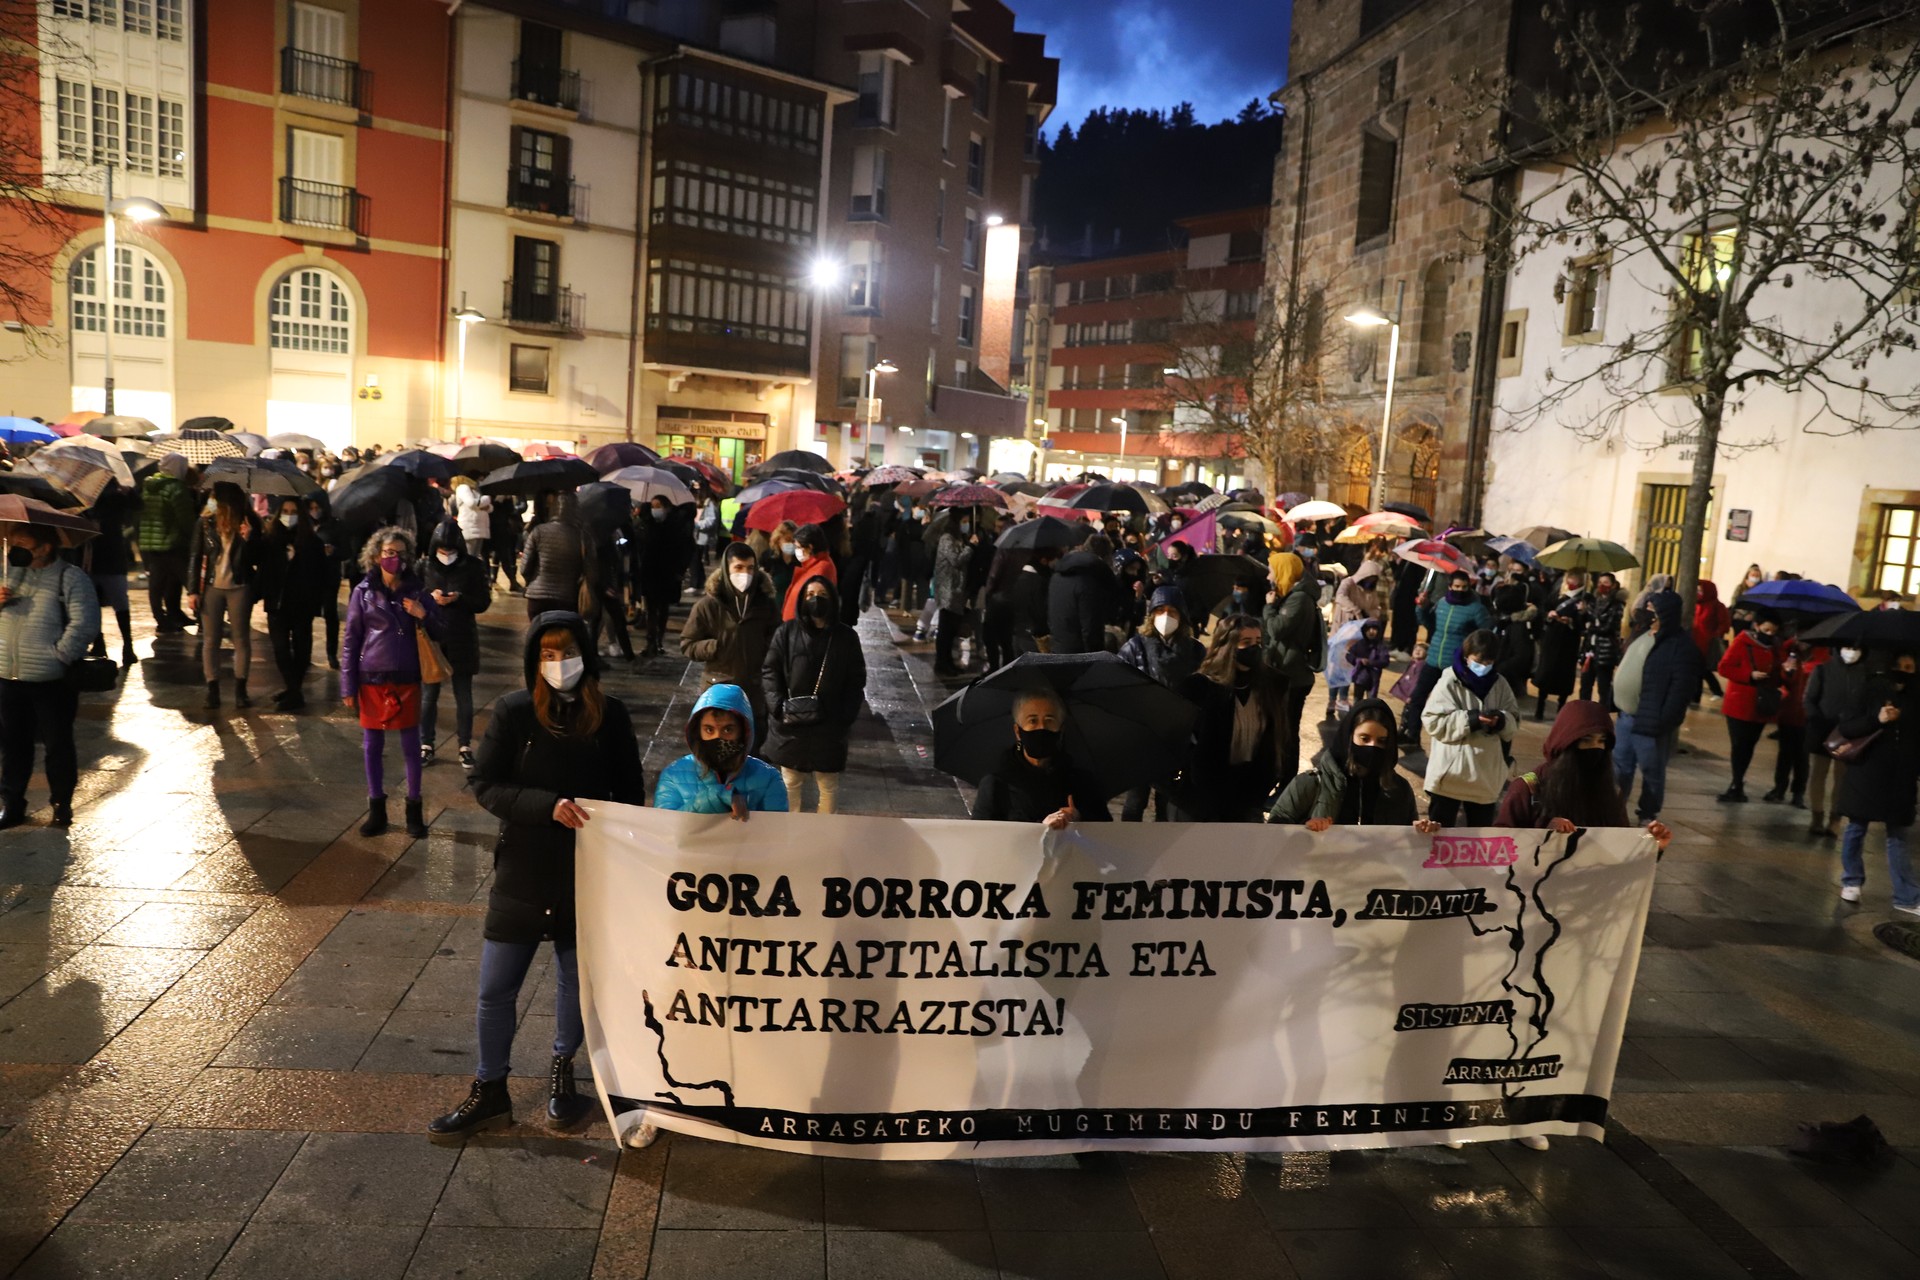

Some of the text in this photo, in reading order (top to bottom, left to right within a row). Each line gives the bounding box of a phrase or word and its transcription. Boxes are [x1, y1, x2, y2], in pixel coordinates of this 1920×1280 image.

[1432, 840, 1513, 865] DENA
[666, 872, 1348, 928] GORA BORROKA FEMINISTA,
[1368, 892, 1480, 917] ALDATU
[666, 932, 1217, 978] ANTIKAPITALISTA ETA
[666, 988, 1066, 1037] ANTIARRAZISTA!
[1401, 1003, 1508, 1030] SISTEMA
[1446, 1061, 1560, 1080] ARRAKALATU
[760, 1106, 1507, 1138] ARRASATEKO MUGIMENDU FEMINISTA
